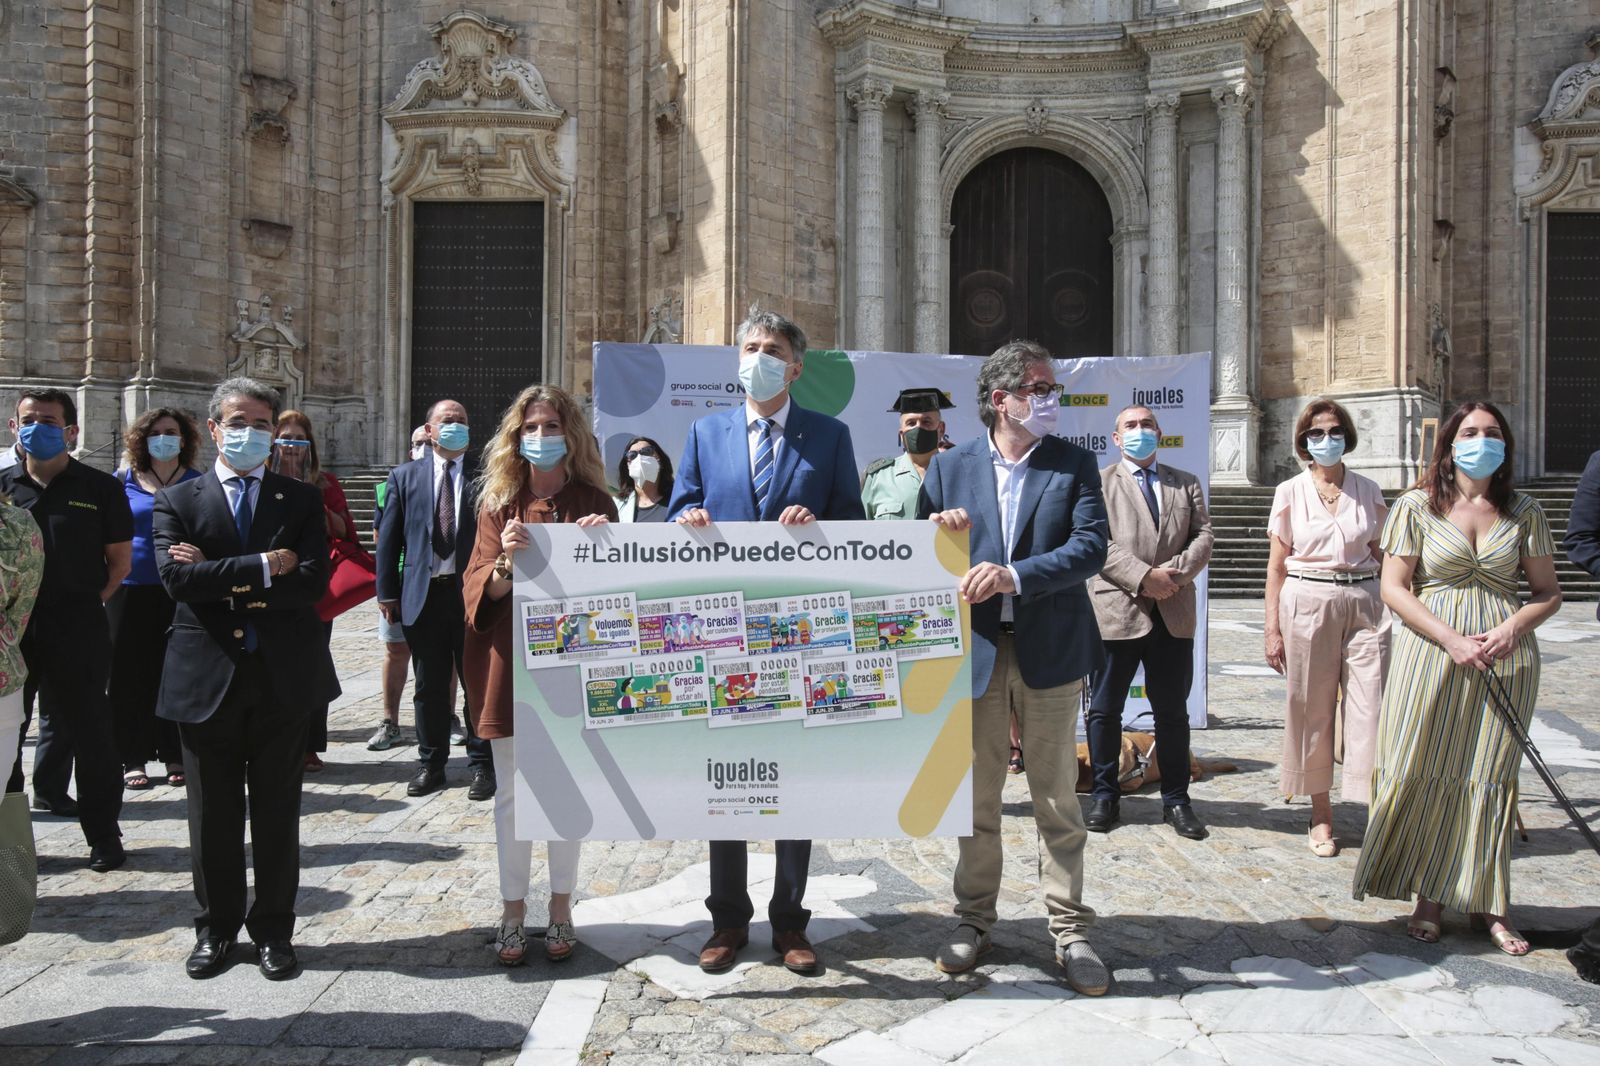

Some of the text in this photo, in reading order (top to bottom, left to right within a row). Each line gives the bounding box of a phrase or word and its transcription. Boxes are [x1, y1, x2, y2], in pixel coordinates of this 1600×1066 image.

[1072, 396, 1107, 405] ONCE
[573, 539, 913, 563] #LaIlusiónPuedeConTodo
[595, 618, 632, 630] Volvemos
[707, 615, 738, 628] Gracias
[815, 614, 846, 627] Gracias
[922, 618, 954, 630] Gracias
[609, 629, 630, 639] iguales
[675, 675, 703, 687] Gracias
[760, 671, 786, 681] Gracias
[853, 672, 881, 684] Gracias
[708, 758, 778, 790] iguales
